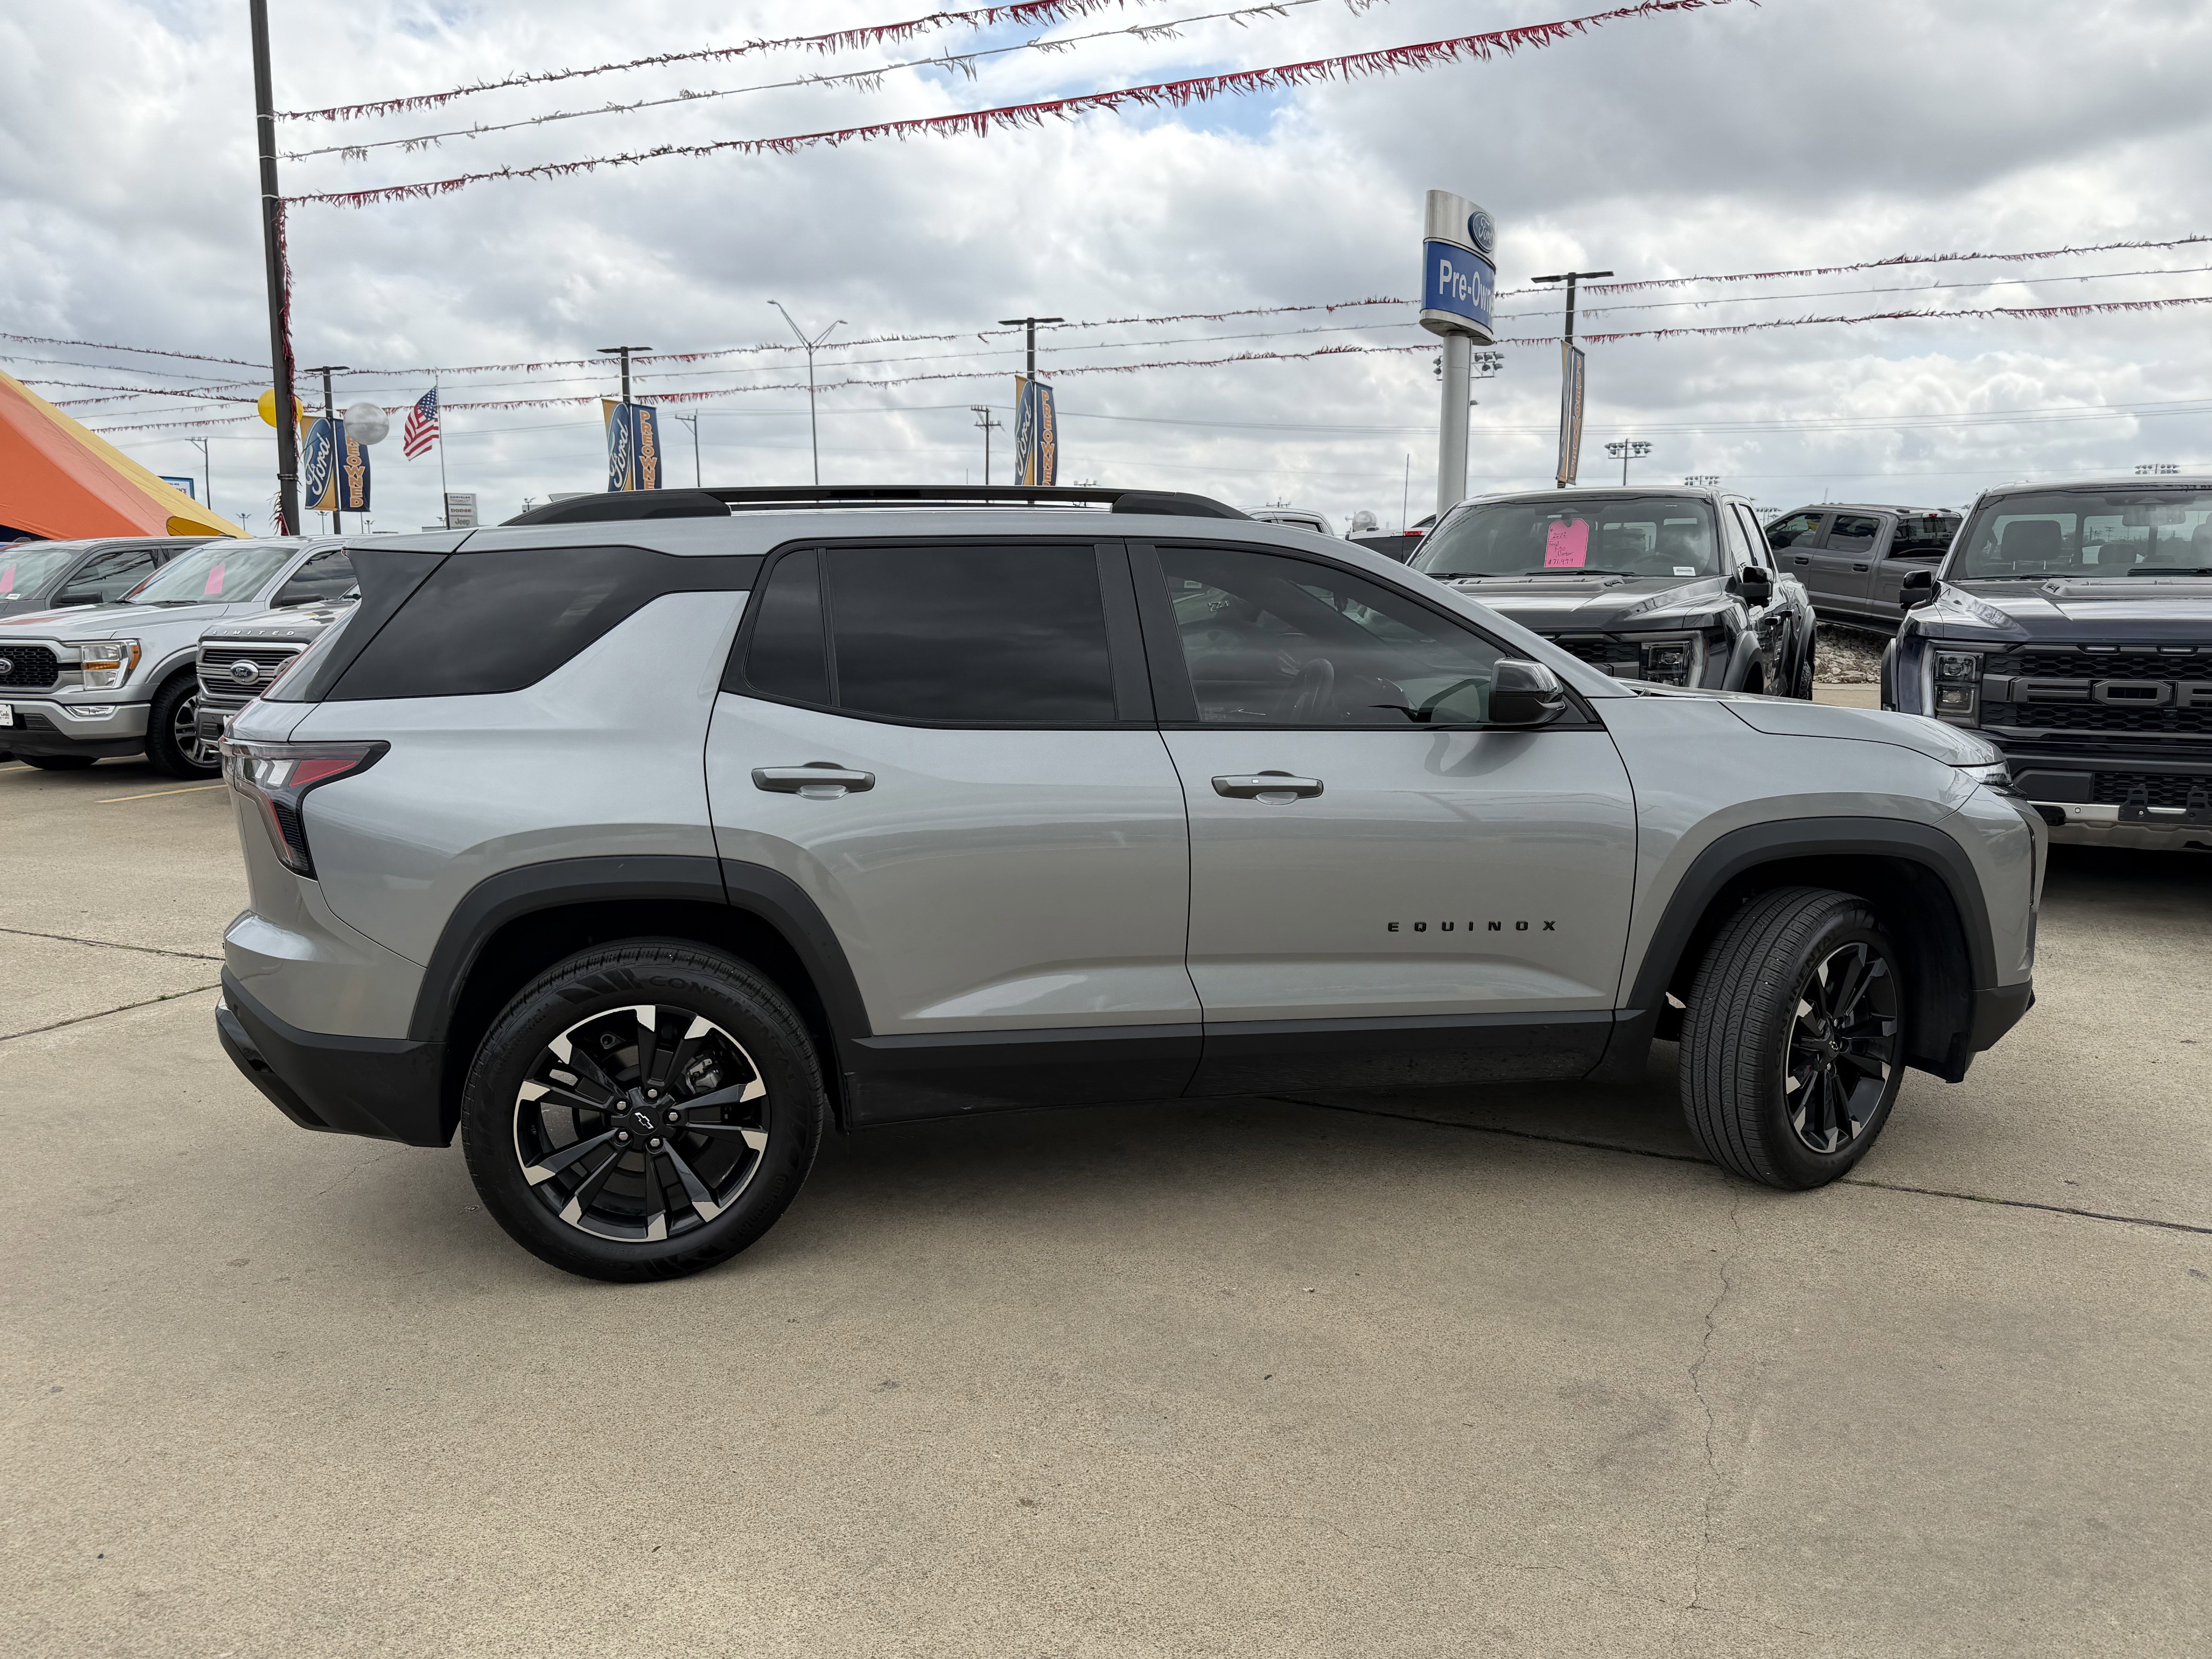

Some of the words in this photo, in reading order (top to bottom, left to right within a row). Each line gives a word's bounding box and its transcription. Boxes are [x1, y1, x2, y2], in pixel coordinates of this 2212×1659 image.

[1478, 217, 1493, 244] Ford
[305, 433, 330, 496] Ford
[610, 418, 629, 488] Ford
[455, 518, 470, 526] Jeep
[235, 667, 248, 677] Ford
[1388, 920, 1556, 933] EQUINOX
[648, 974, 798, 1089] CONTINENTAL
